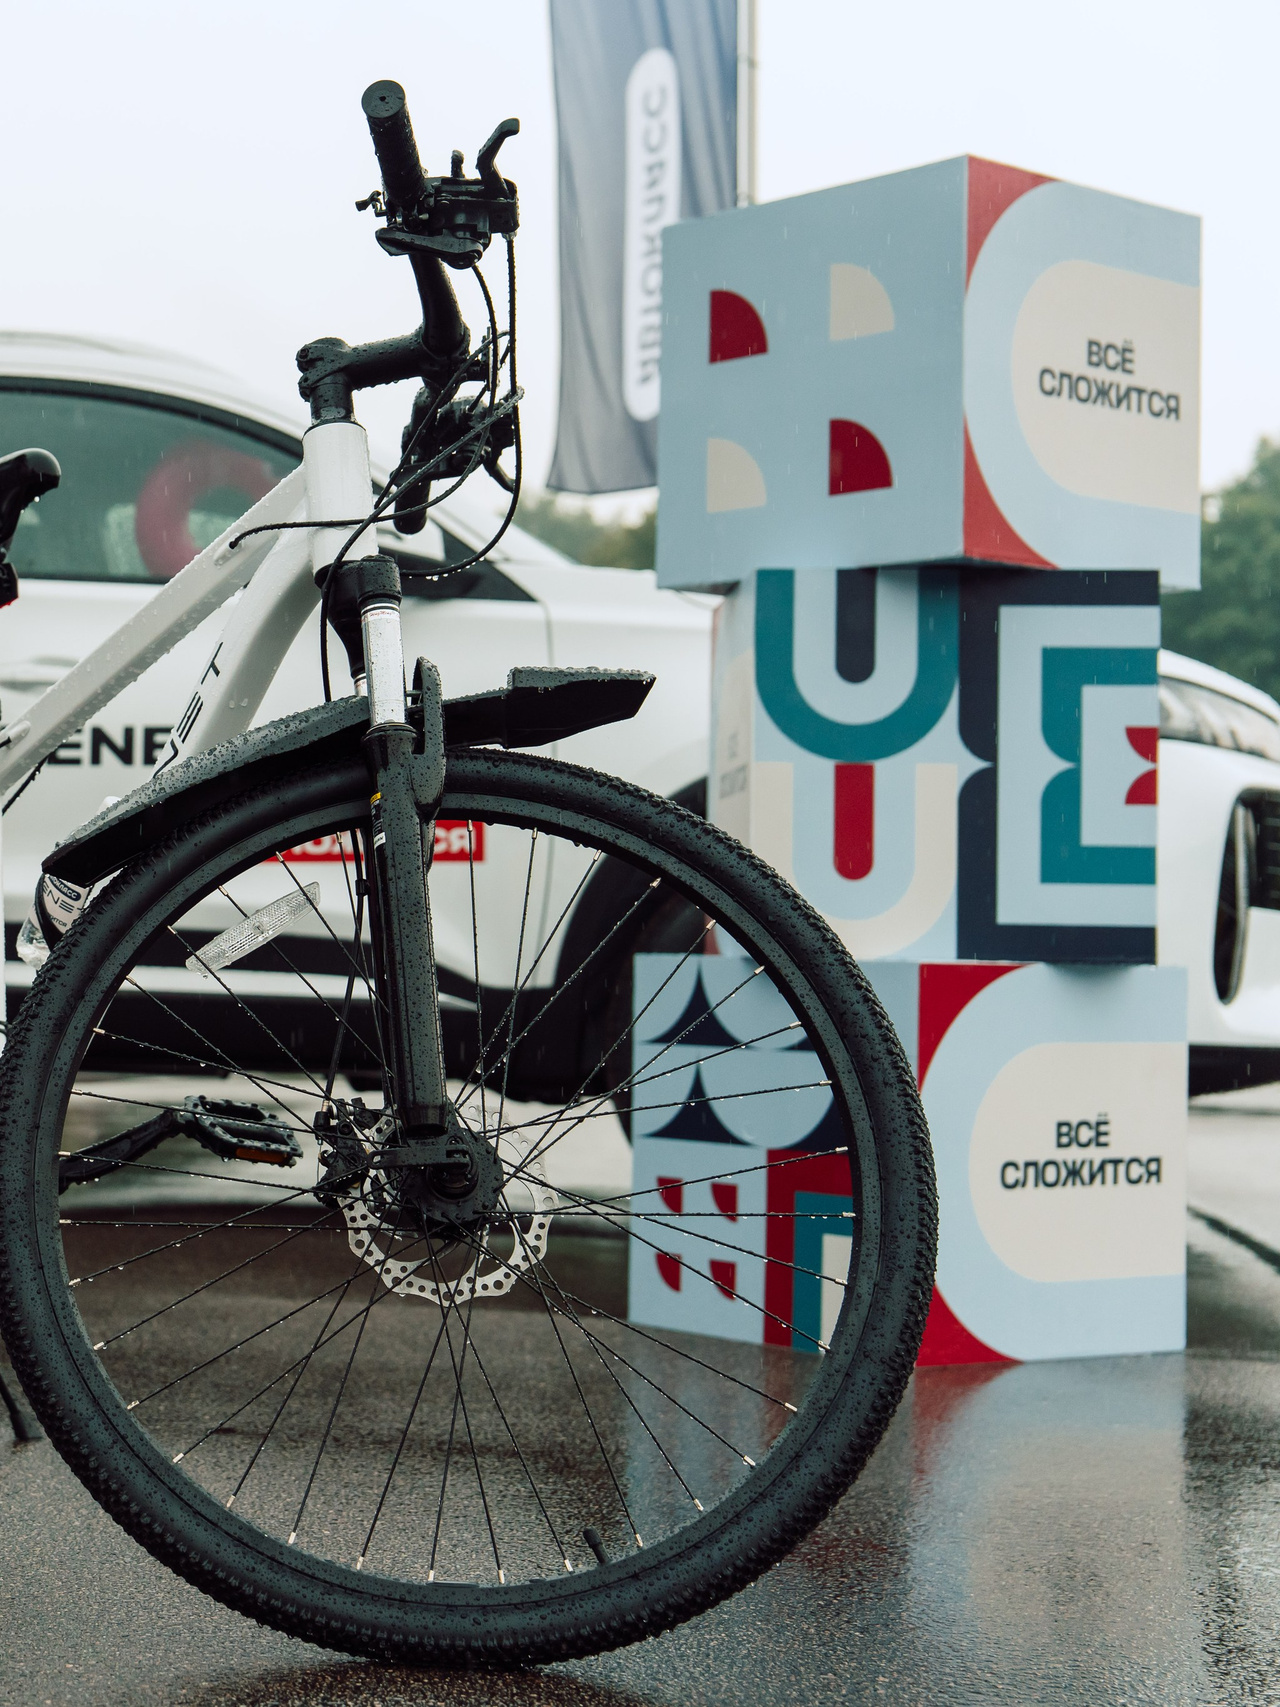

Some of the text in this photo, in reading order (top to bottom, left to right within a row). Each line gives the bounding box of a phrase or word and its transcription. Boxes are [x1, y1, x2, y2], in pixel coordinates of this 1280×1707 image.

[1086, 338, 1135, 375] ВСЁ
[1038, 367, 1181, 421] СЛОЖИТСЯ
[45, 726, 176, 766] ENE
[1056, 1112, 1110, 1148] ВСЁ
[1000, 1157, 1162, 1189] СЛОЖИТСЯ
